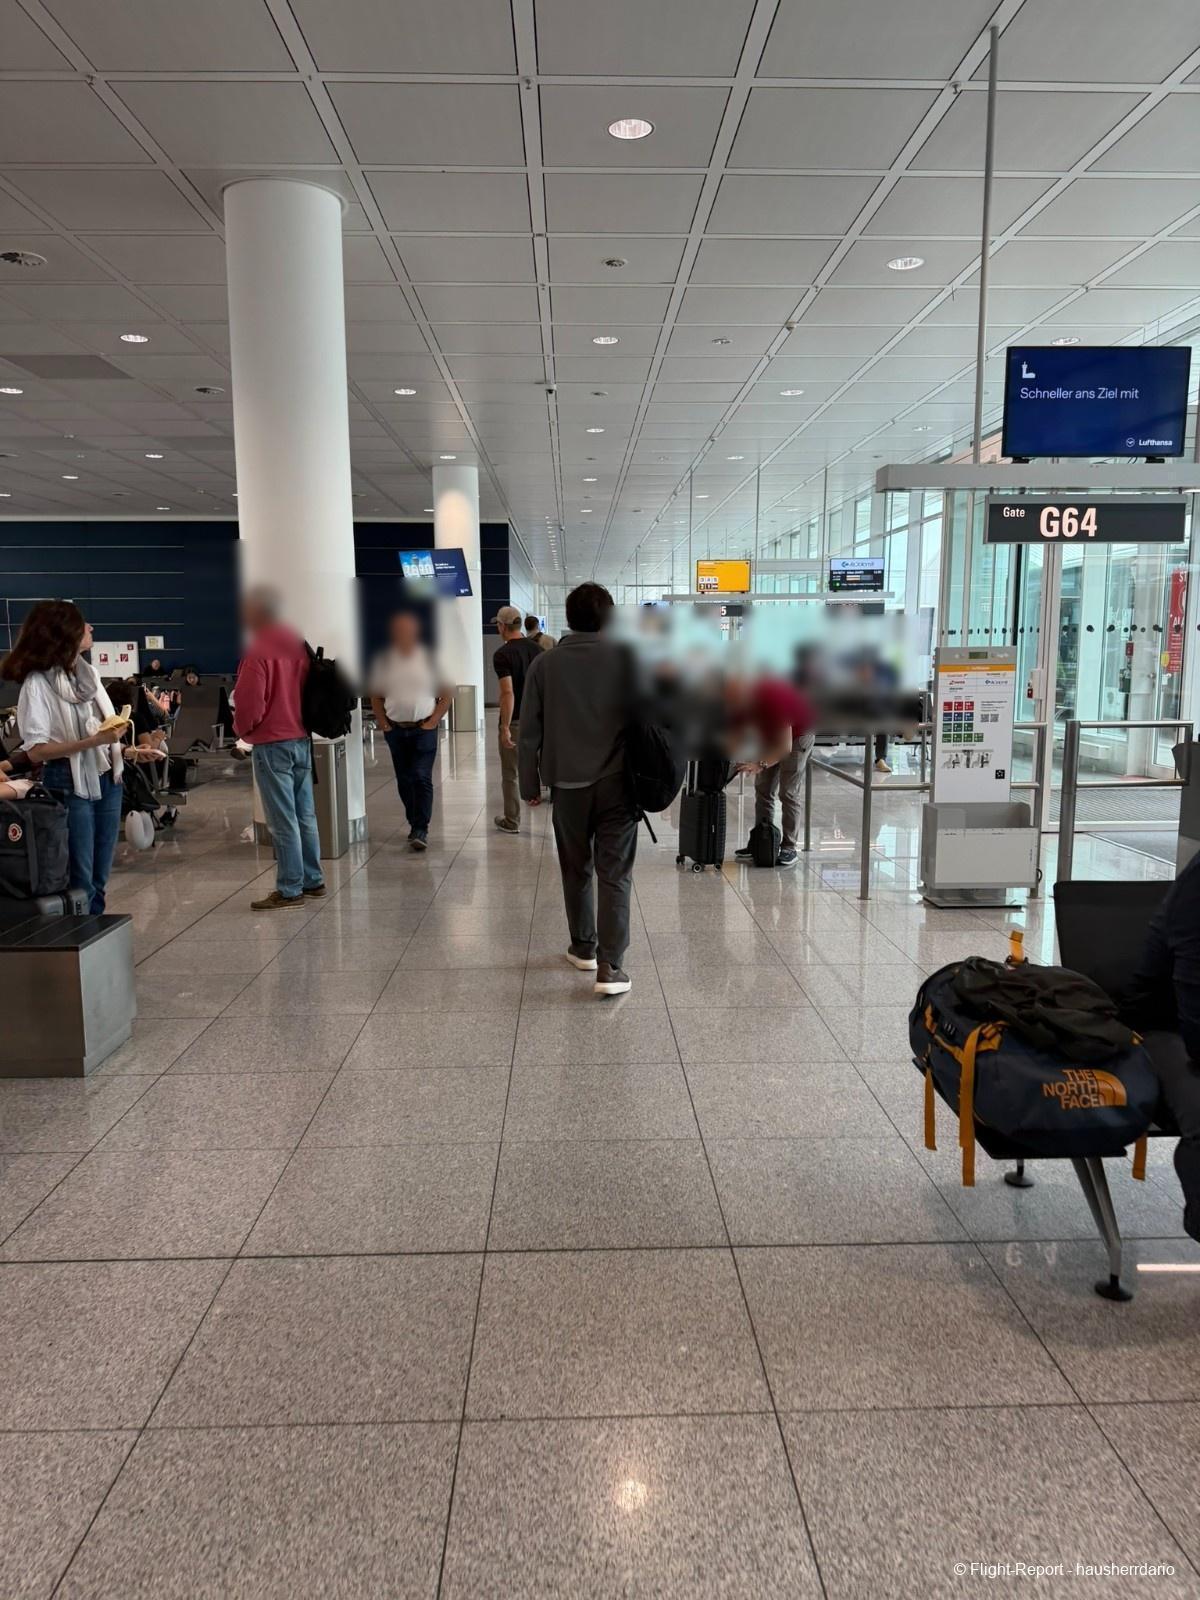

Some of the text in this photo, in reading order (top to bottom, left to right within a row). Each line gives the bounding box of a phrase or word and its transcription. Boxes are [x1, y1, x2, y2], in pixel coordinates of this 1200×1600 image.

[1020, 388, 1139, 399] Schneller ans Ziel mit
[1003, 506, 1098, 538] Gate G64
[1062, 1068, 1094, 1081] THE
[1042, 1080, 1098, 1097] NORTH
[1060, 1094, 1100, 1110] FACE
